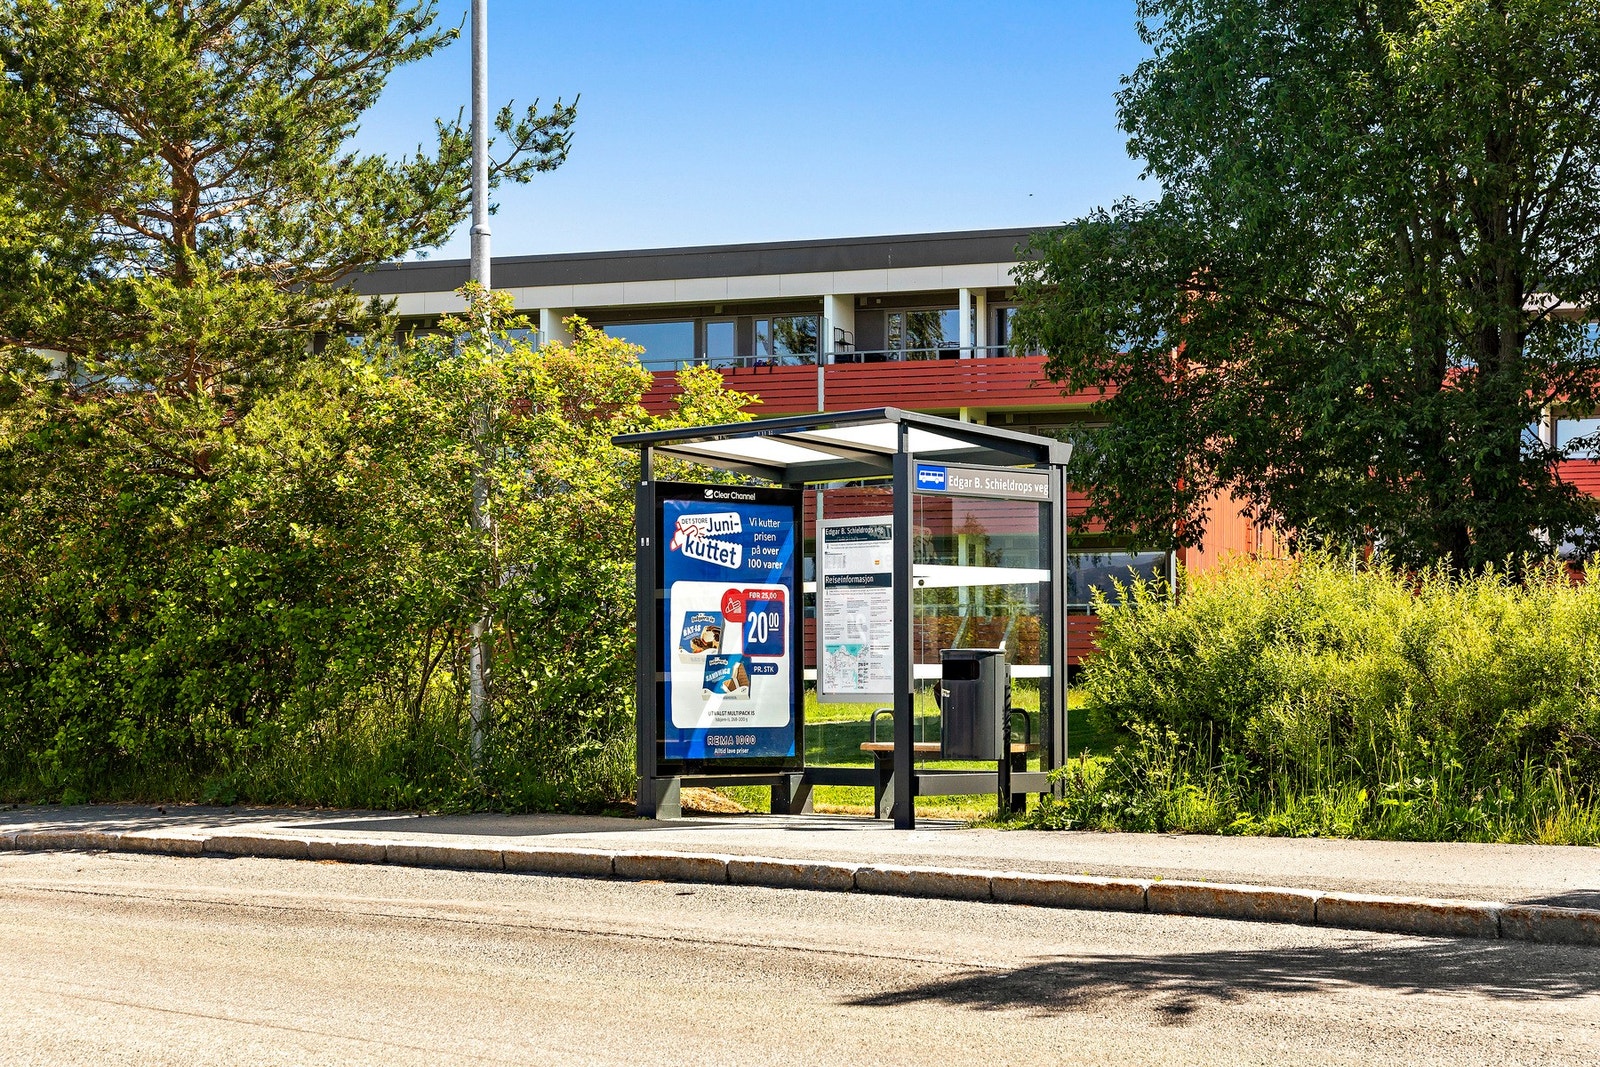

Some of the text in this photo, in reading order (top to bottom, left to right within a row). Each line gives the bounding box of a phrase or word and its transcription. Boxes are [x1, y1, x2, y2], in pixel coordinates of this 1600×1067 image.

[949, 475, 1048, 495] Edgar B. Schieldrops veg
[713, 490, 756, 501] Clear Channel
[707, 515, 739, 533] Juni-
[749, 517, 781, 528] Vi kutter
[754, 532, 776, 542] prisen
[825, 527, 840, 536] Edgar
[841, 527, 846, 535] B.
[685, 535, 737, 566] kuttet
[751, 545, 779, 555] på over
[748, 558, 783, 569] 100 varer
[825, 574, 874, 585] Reiseinformasjon
[761, 592, 777, 600] 25,00
[753, 663, 775, 673] PR. STK
[707, 734, 756, 746] REMA 1000
[736, 747, 749, 755] priser
